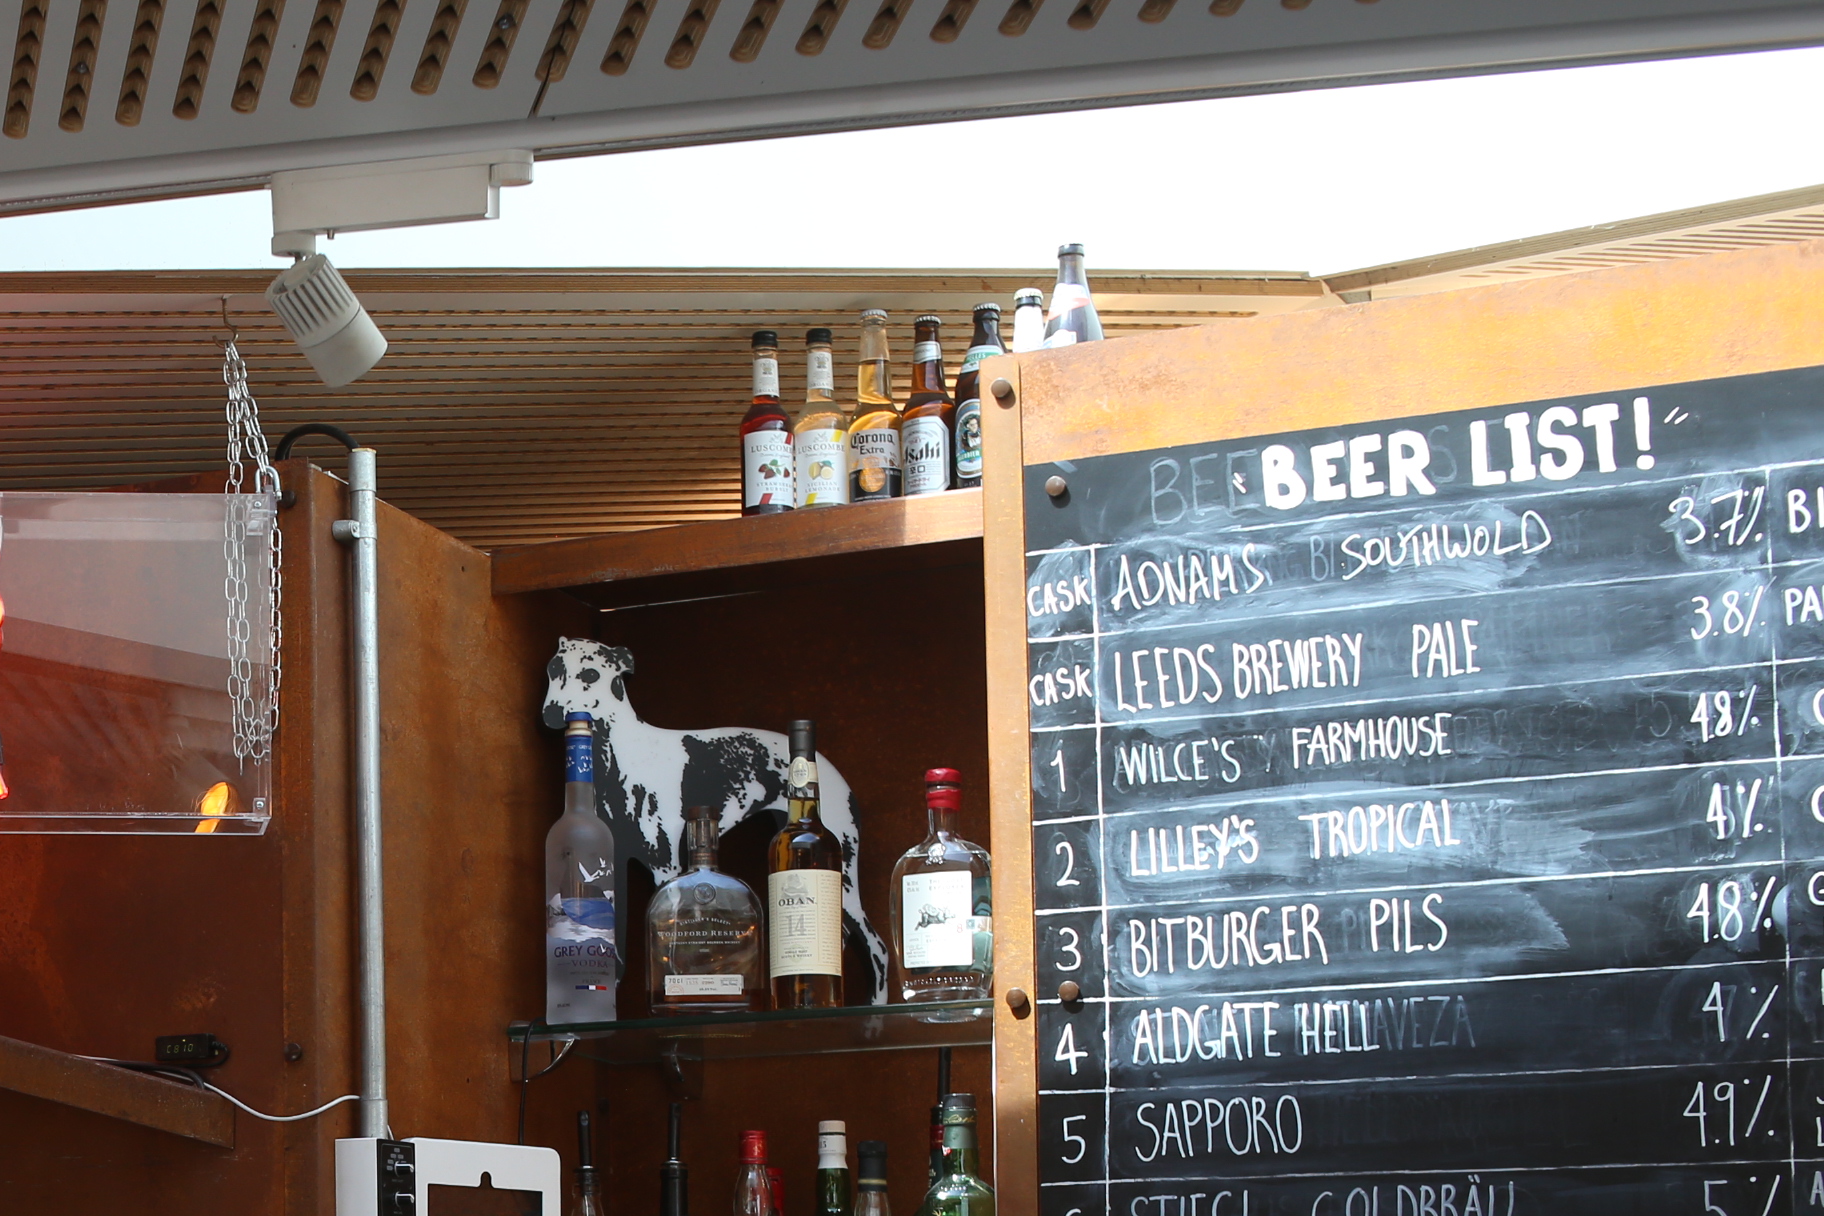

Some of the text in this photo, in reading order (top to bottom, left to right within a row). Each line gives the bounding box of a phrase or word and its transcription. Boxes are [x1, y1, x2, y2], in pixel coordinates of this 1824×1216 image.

[851, 432, 895, 449] Corona
[859, 445, 885, 455] Extra
[1027, 577, 1092, 617] CASK
[1111, 543, 1267, 611] ADNAMS
[1344, 510, 1552, 580] SOUTHWOLD
[1030, 666, 1092, 707] CASK
[1114, 642, 1223, 714] LEEDS
[1232, 632, 1364, 696] BREWERY
[1411, 619, 1481, 679] PALE
[1049, 712, 1453, 794] 1 WILCE'S FARMHOUSE
[1055, 842, 1080, 886] 2
[1298, 799, 1460, 857] TROPICAL
[554, 945, 583, 959] GREY
[785, 914, 806, 937] 14
[1055, 928, 1082, 971] 3
[1128, 902, 1328, 977] BITBURGER
[1368, 893, 1448, 954] PILS
[572, 959, 608, 968] VODKA
[1054, 1025, 1087, 1075] 4
[1132, 1002, 1282, 1065] ALDGATE
[1063, 1115, 1086, 1164] 5
[1135, 1094, 1303, 1161] SAPPORO
